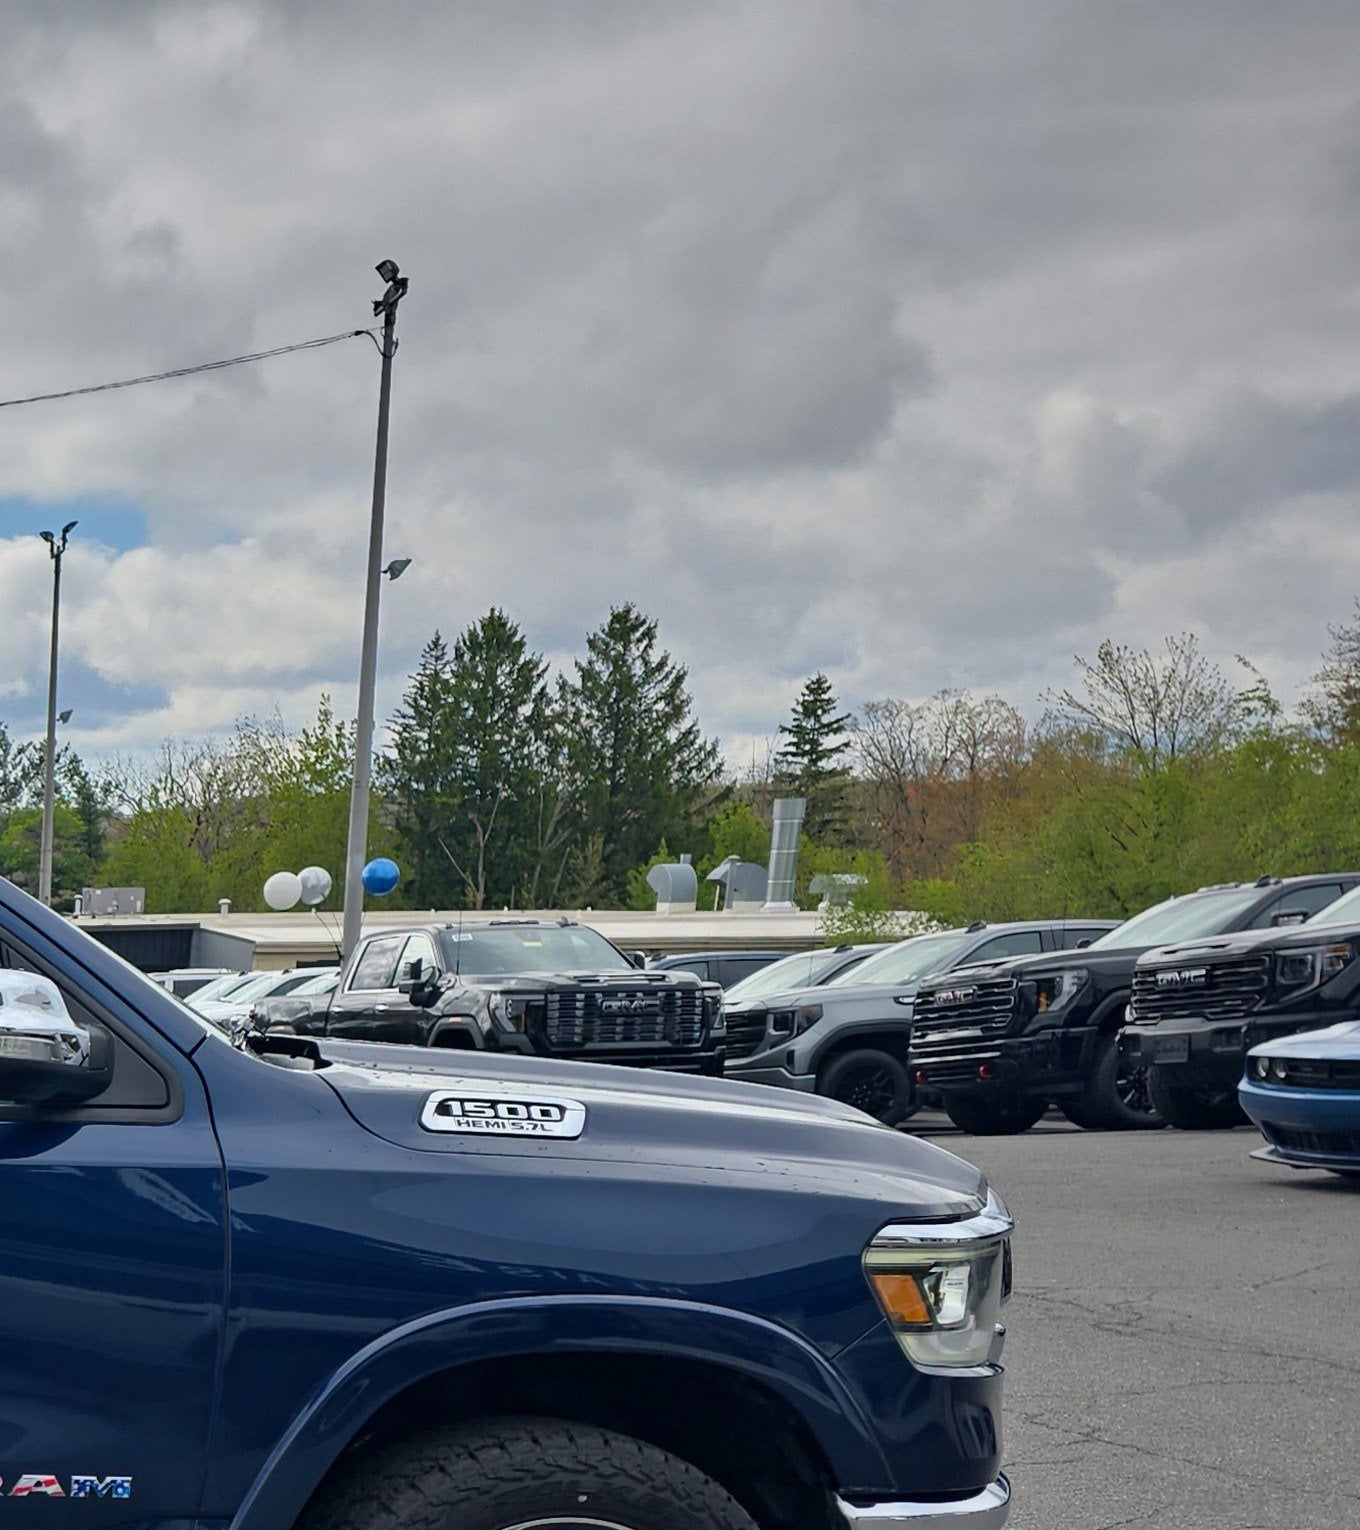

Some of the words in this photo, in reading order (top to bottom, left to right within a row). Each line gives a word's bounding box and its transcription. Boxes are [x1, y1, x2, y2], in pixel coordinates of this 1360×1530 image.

[601, 1000, 661, 1014] GMC
[443, 1100, 563, 1121] 1500
[456, 1118, 507, 1130] HEMI
[511, 1121, 554, 1132] 5.7L
